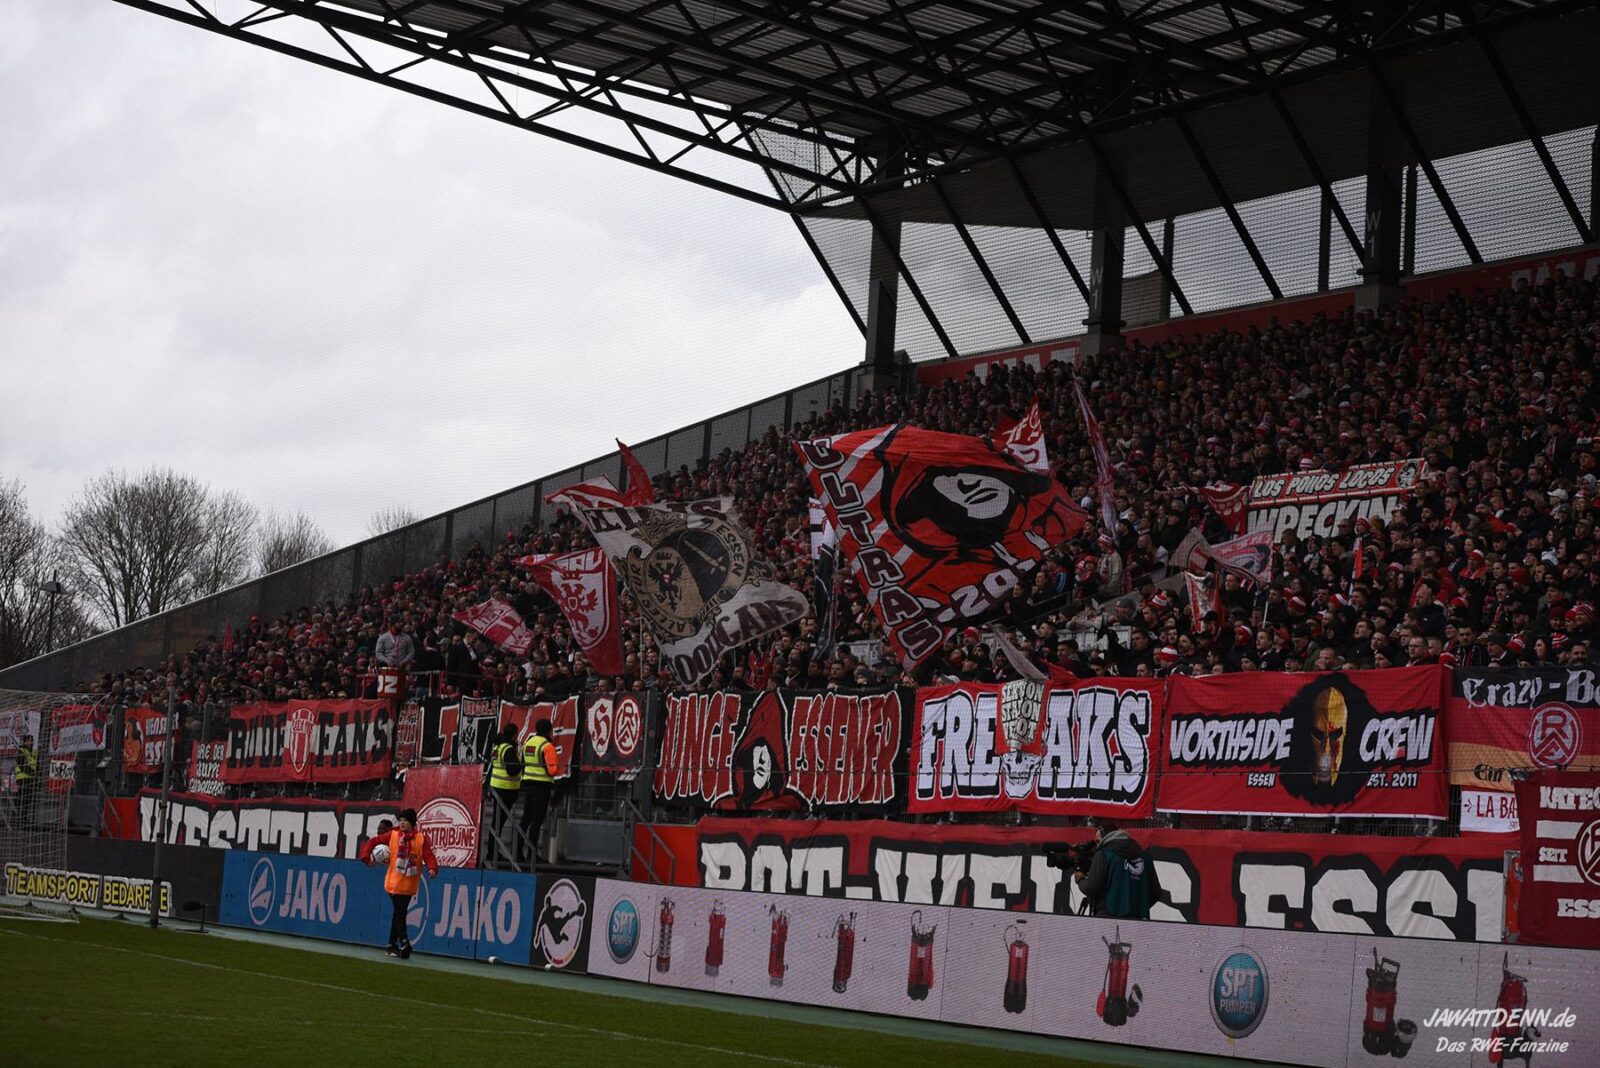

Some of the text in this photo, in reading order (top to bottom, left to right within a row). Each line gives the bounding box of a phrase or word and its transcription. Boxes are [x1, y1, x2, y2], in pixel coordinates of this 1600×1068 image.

[1252, 478, 1286, 498] LOS
[1339, 467, 1396, 490] LOCOS
[715, 524, 747, 577] ESSEN
[800, 437, 943, 661] ULTRAS
[630, 563, 647, 595] FÜR
[316, 708, 390, 768] FANS
[652, 691, 742, 801] JUNGE
[786, 690, 903, 806] ESSENER
[916, 686, 1151, 807] FREAKS
[1359, 713, 1436, 762] CREW
[1247, 772, 1276, 787] ESSEN
[1366, 771, 1419, 788] EST. 2011
[1476, 795, 1519, 819] LA BA
[1538, 847, 1569, 863] SEIT
[6, 865, 98, 903] TEAMSPORT
[279, 871, 348, 924] JAKO
[434, 883, 521, 944] JAKO
[612, 910, 635, 935] SPT
[1220, 967, 1259, 999] SPT
[1219, 997, 1257, 1016] PUMPEN
